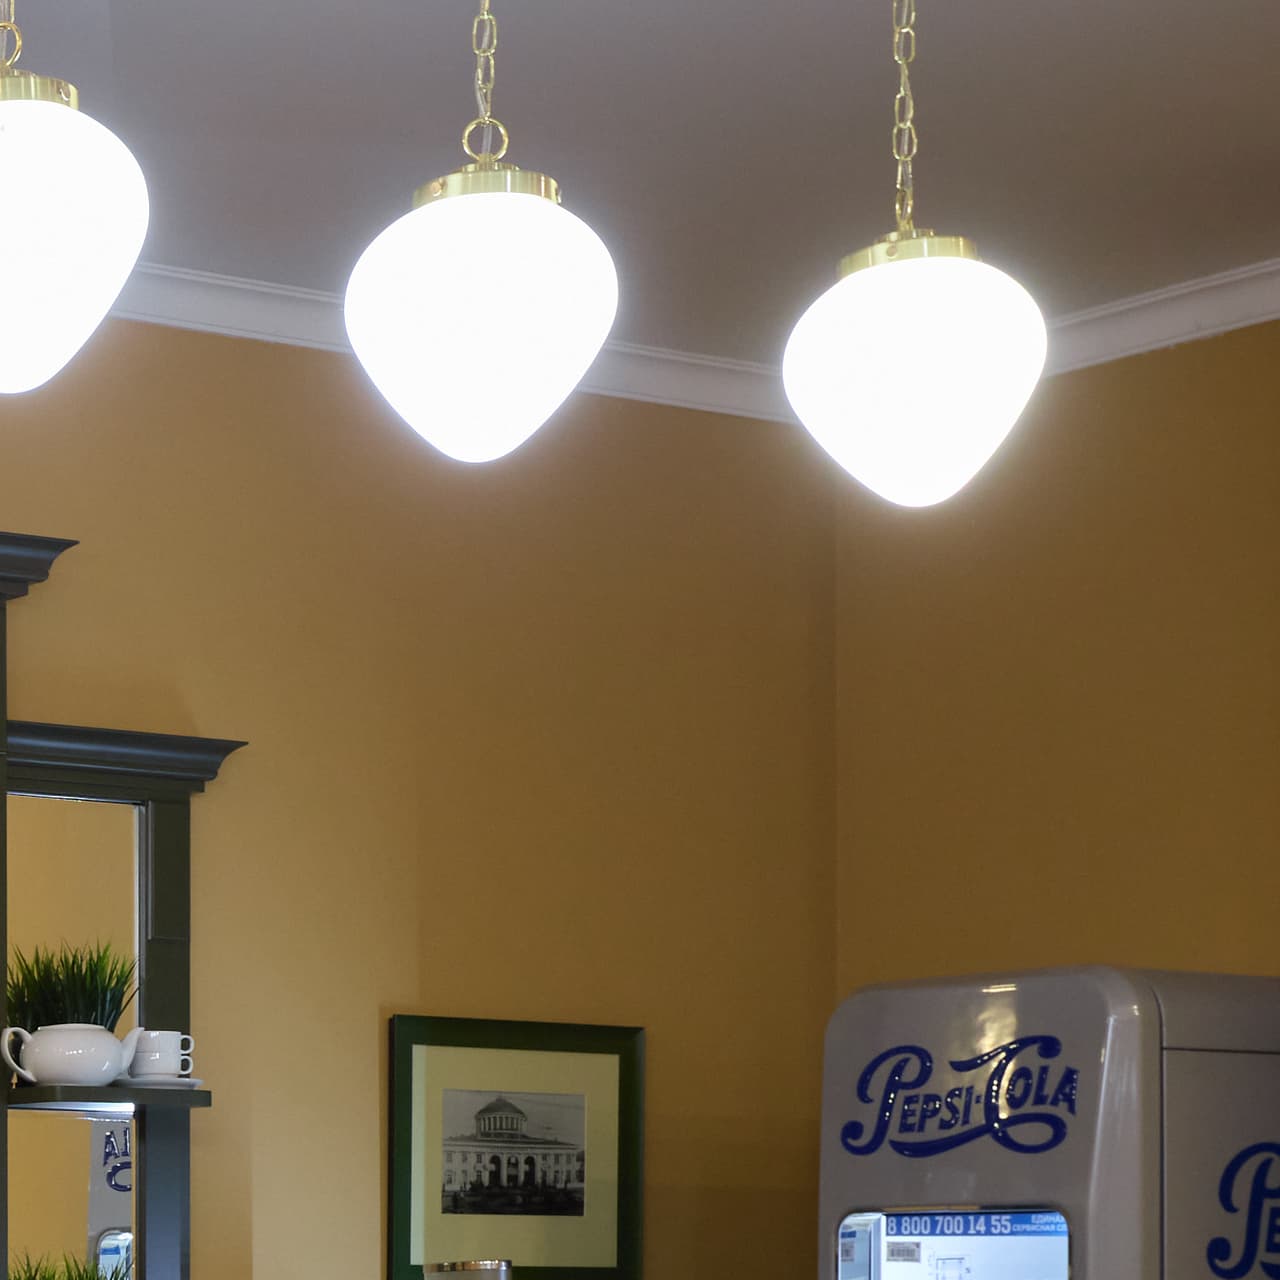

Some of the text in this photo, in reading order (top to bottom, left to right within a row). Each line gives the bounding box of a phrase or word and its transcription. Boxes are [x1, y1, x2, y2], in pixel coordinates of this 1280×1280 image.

[887, 1215, 1012, 1235] 8 800 700 14 55
